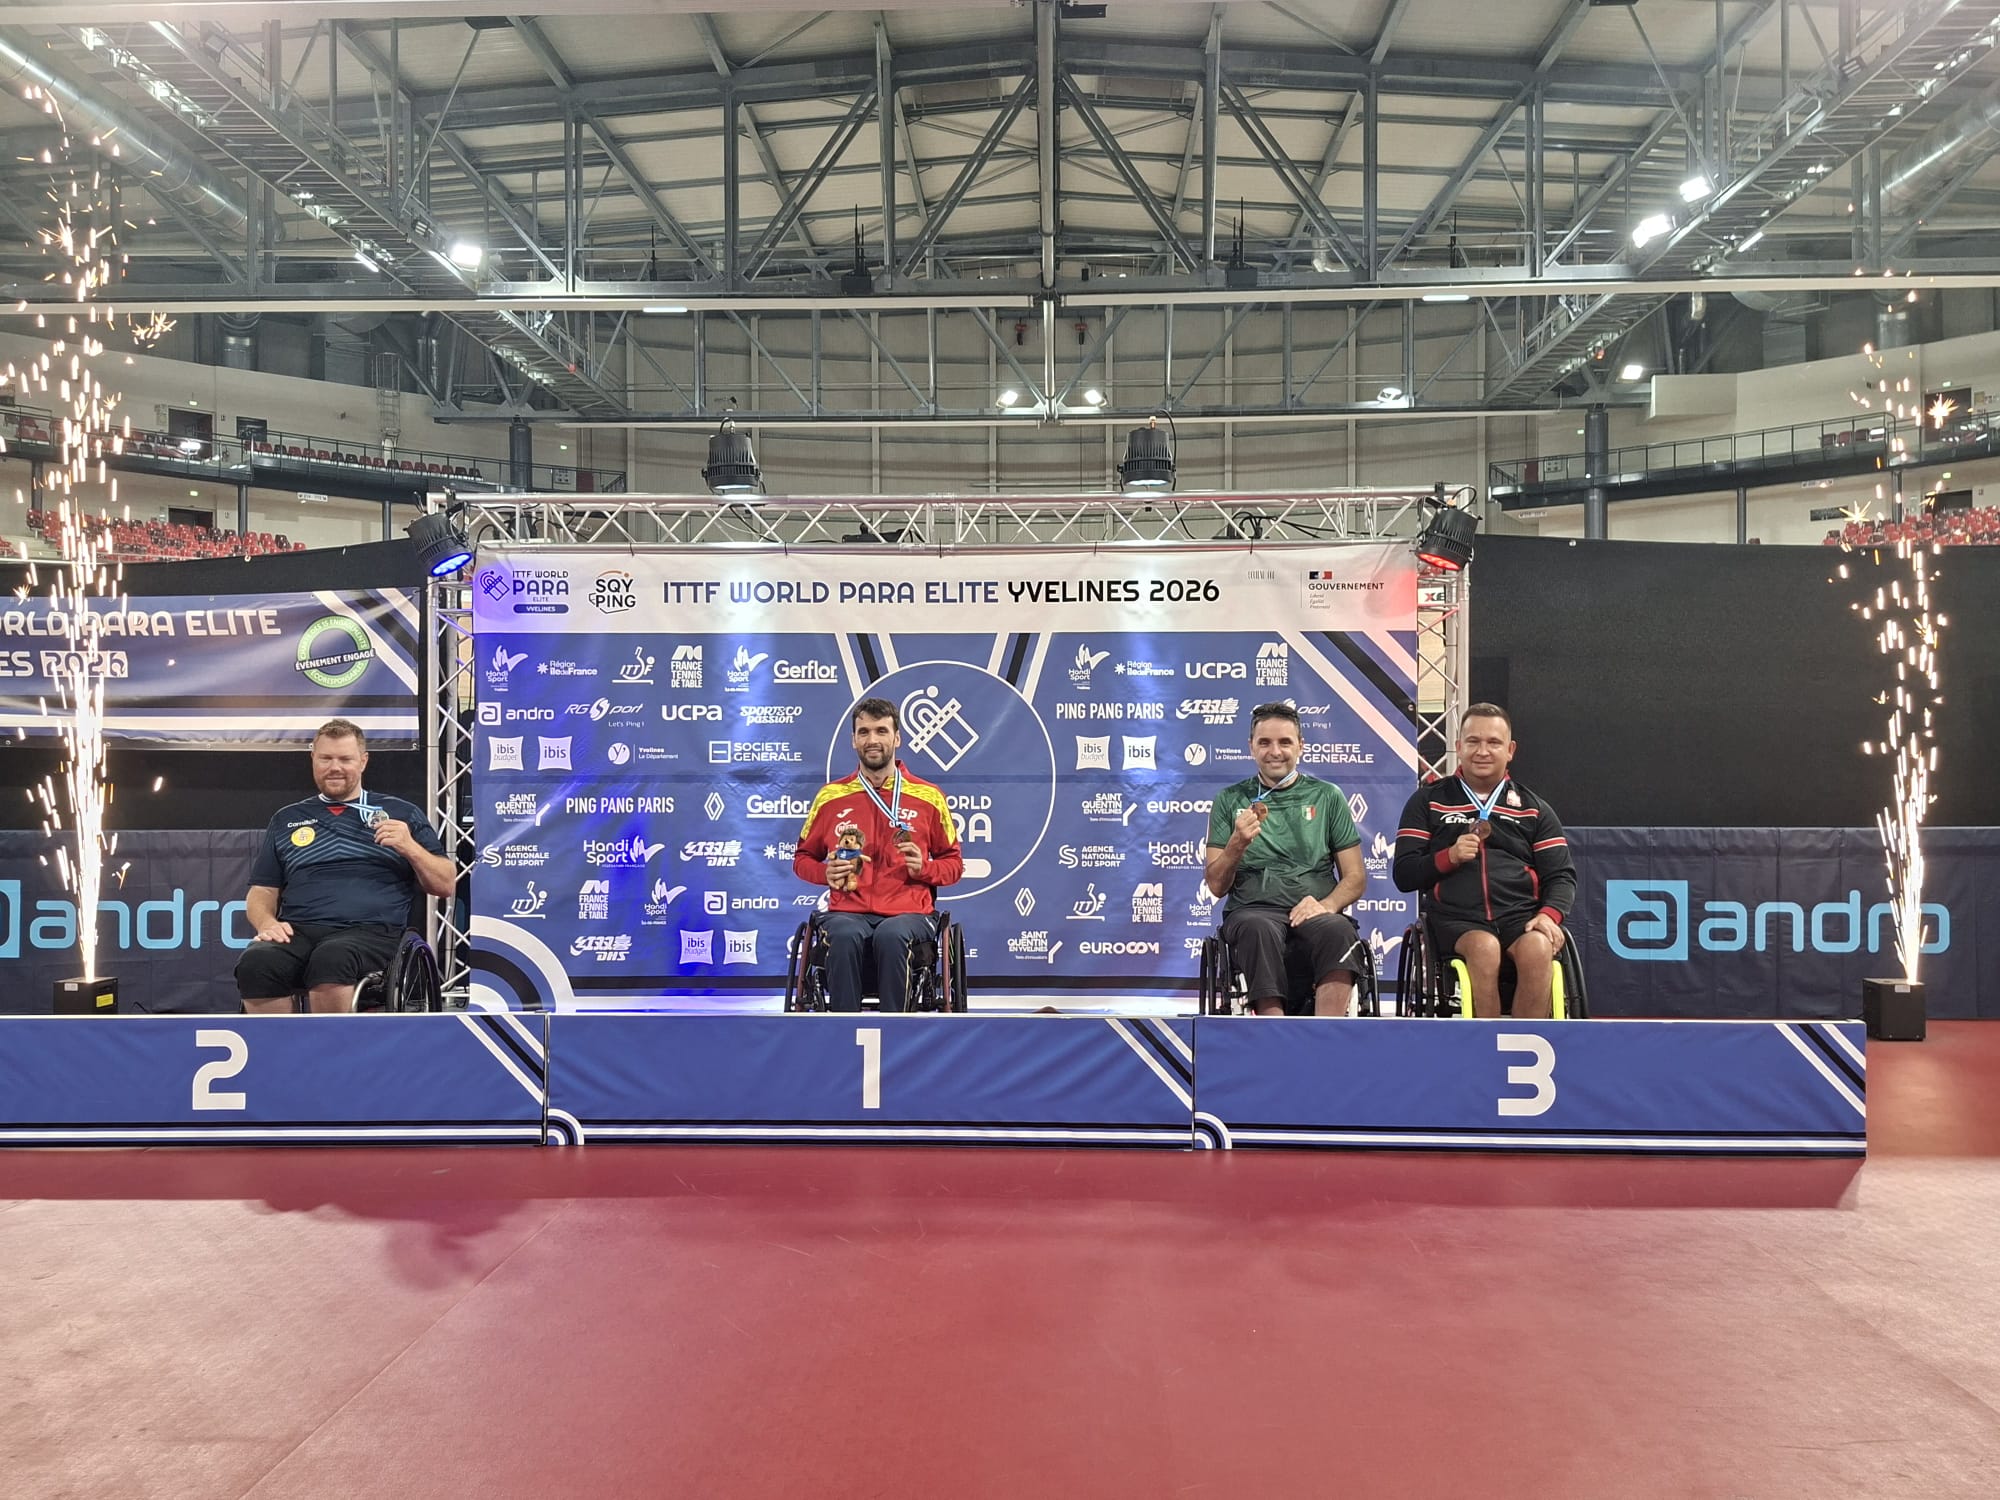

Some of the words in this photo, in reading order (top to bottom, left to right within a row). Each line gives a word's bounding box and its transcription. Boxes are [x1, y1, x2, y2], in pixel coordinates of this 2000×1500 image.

[513, 580, 569, 595] PARA
[596, 579, 634, 592] SQY
[1308, 582, 1385, 591] GOUVERNEMENT
[664, 582, 720, 603] ITTF
[730, 582, 830, 603] WORLD
[840, 582, 914, 603] PARA
[925, 581, 999, 603] ELITE
[1008, 580, 1140, 603] YVELINES
[1150, 579, 1220, 602] 2026
[596, 595, 636, 607] PING
[0, 611, 68, 636] RLD
[81, 611, 175, 636] PARA
[185, 609, 282, 636] ELITE
[343, 648, 376, 663] ENGAGÉ
[42, 651, 127, 677] 2026
[550, 660, 575, 668] Région
[671, 661, 703, 670] FRANCE
[1127, 661, 1152, 669] Région
[1255, 658, 1288, 667] FRANCE
[773, 660, 836, 679] Gerflor
[1256, 668, 1288, 676] TENNIS
[671, 671, 703, 679] TENNIS
[671, 680, 680, 688] DE
[681, 680, 703, 688] TABLE
[1256, 677, 1265, 686] DE
[1266, 677, 1288, 686] TABLE
[505, 707, 554, 720] andro
[1056, 703, 1085, 719] PING
[1090, 703, 1123, 719] PANG
[1127, 703, 1164, 719] PARIS
[746, 715, 795, 726] passion
[1202, 714, 1237, 724] DHS
[496, 744, 515, 754] ibis
[733, 742, 790, 751] SOCIETE
[1083, 744, 1102, 753] ibis
[1303, 743, 1361, 753] SOCIETE
[494, 753, 517, 761] budget
[544, 746, 567, 759] ibis
[733, 752, 803, 761] GENERALE
[1081, 753, 1104, 761] budget
[1128, 746, 1151, 758] ibis
[1302, 754, 1375, 763] GENERALE
[495, 801, 536, 809] QUENTIN
[566, 798, 597, 813] PING
[601, 798, 634, 813] PANG
[638, 798, 675, 813] PARIS
[746, 795, 809, 815] Gerflor
[946, 795, 992, 810] ORLD
[1082, 800, 1122, 809] QUENTIN
[952, 812, 992, 843] RA
[583, 840, 629, 852] Handi
[779, 842, 798, 852] Régi
[1148, 841, 1194, 854] Handi
[586, 852, 628, 866] Sport
[706, 856, 740, 867] DHS
[1152, 853, 1194, 868] Sport
[579, 895, 608, 903] FRANCE
[731, 896, 779, 909] andro
[1132, 898, 1162, 906] FRANCE
[579, 903, 608, 911] TENNIS
[1132, 906, 1162, 914] TENNIS
[1357, 898, 1406, 912] andro
[579, 911, 587, 919] DE
[588, 911, 608, 919] TABLE
[1132, 914, 1141, 922] DE
[1142, 914, 1162, 922] TABLE
[1698, 890, 1951, 953] andro
[687, 938, 705, 947] ibis
[729, 940, 752, 953] ibis
[596, 951, 630, 961] DHS
[192, 1029, 249, 1111] 2
[856, 1028, 881, 1109] 1
[1497, 1033, 1557, 1117] 3
